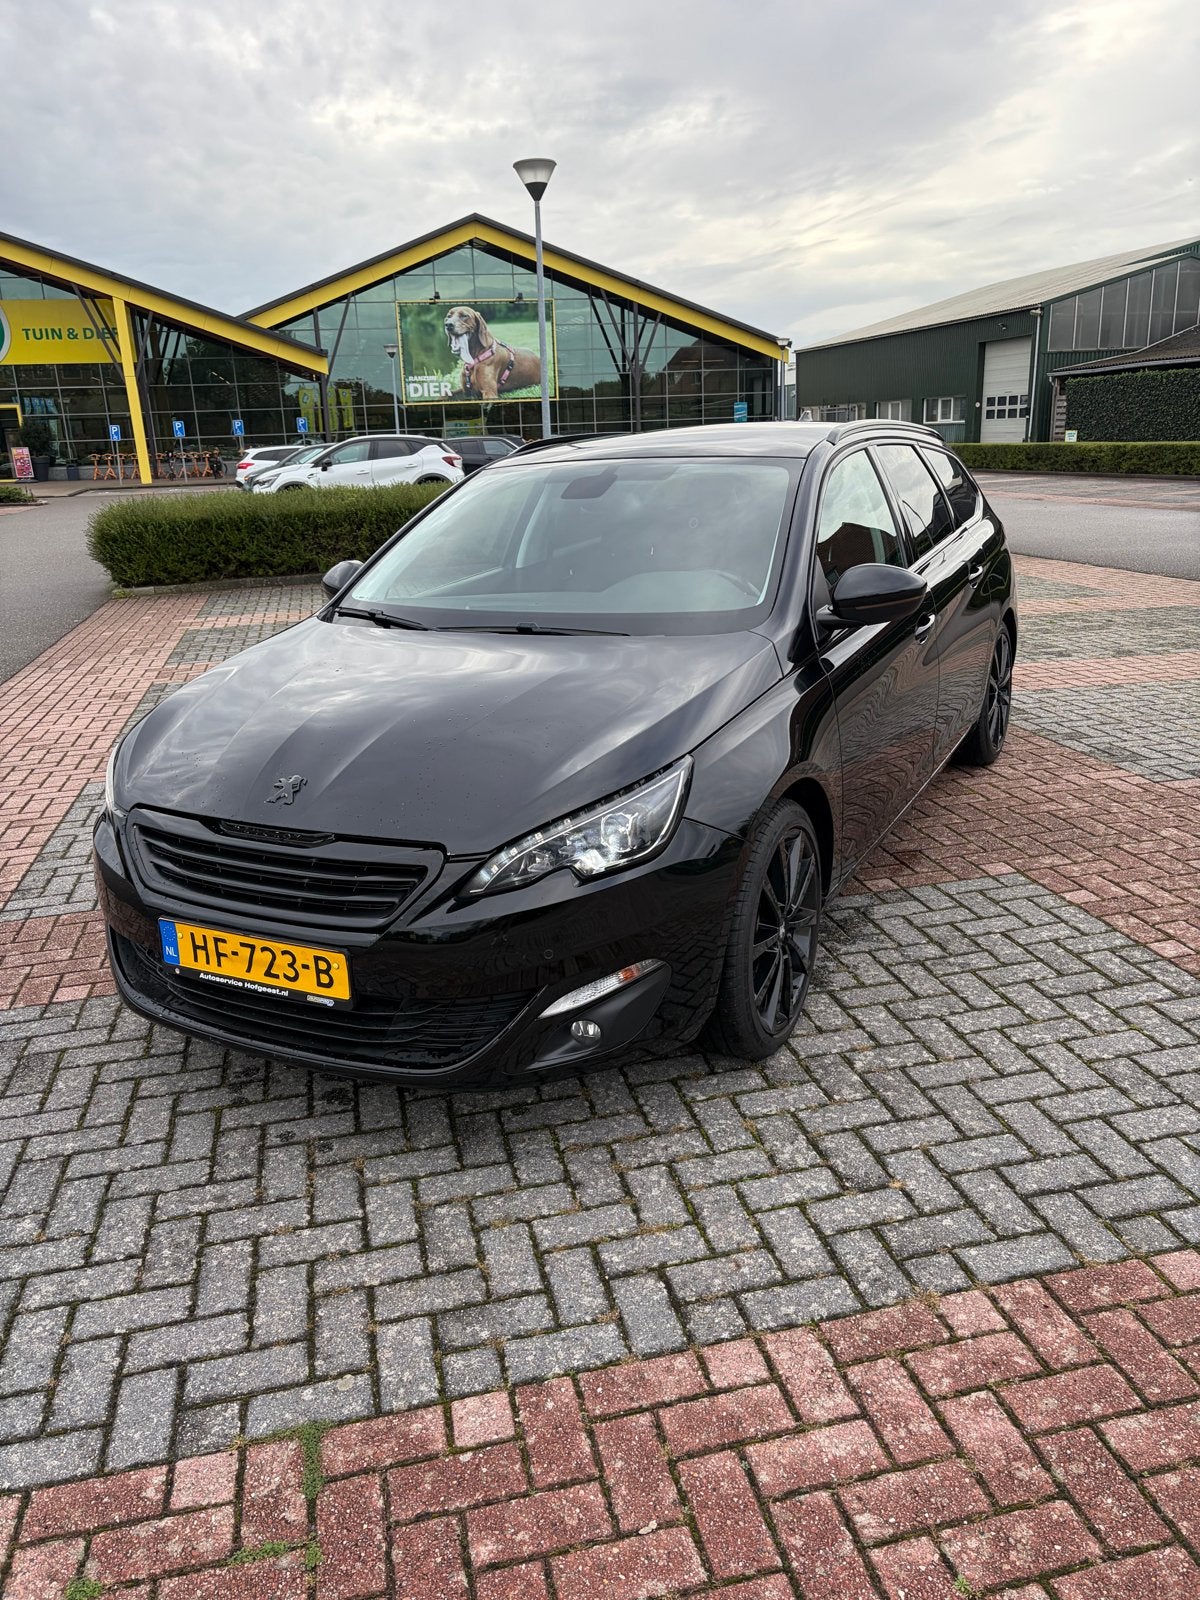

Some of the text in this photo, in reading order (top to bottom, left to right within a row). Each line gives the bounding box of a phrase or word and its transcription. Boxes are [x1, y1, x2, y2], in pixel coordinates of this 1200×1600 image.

[22, 327, 62, 340] TUIN
[67, 327, 79, 340] &
[409, 382, 453, 398] DIER
[165, 945, 178, 957] NL
[190, 932, 334, 989] HF-723-B
[199, 972, 289, 997] Autoservice Hofgeest.nl
